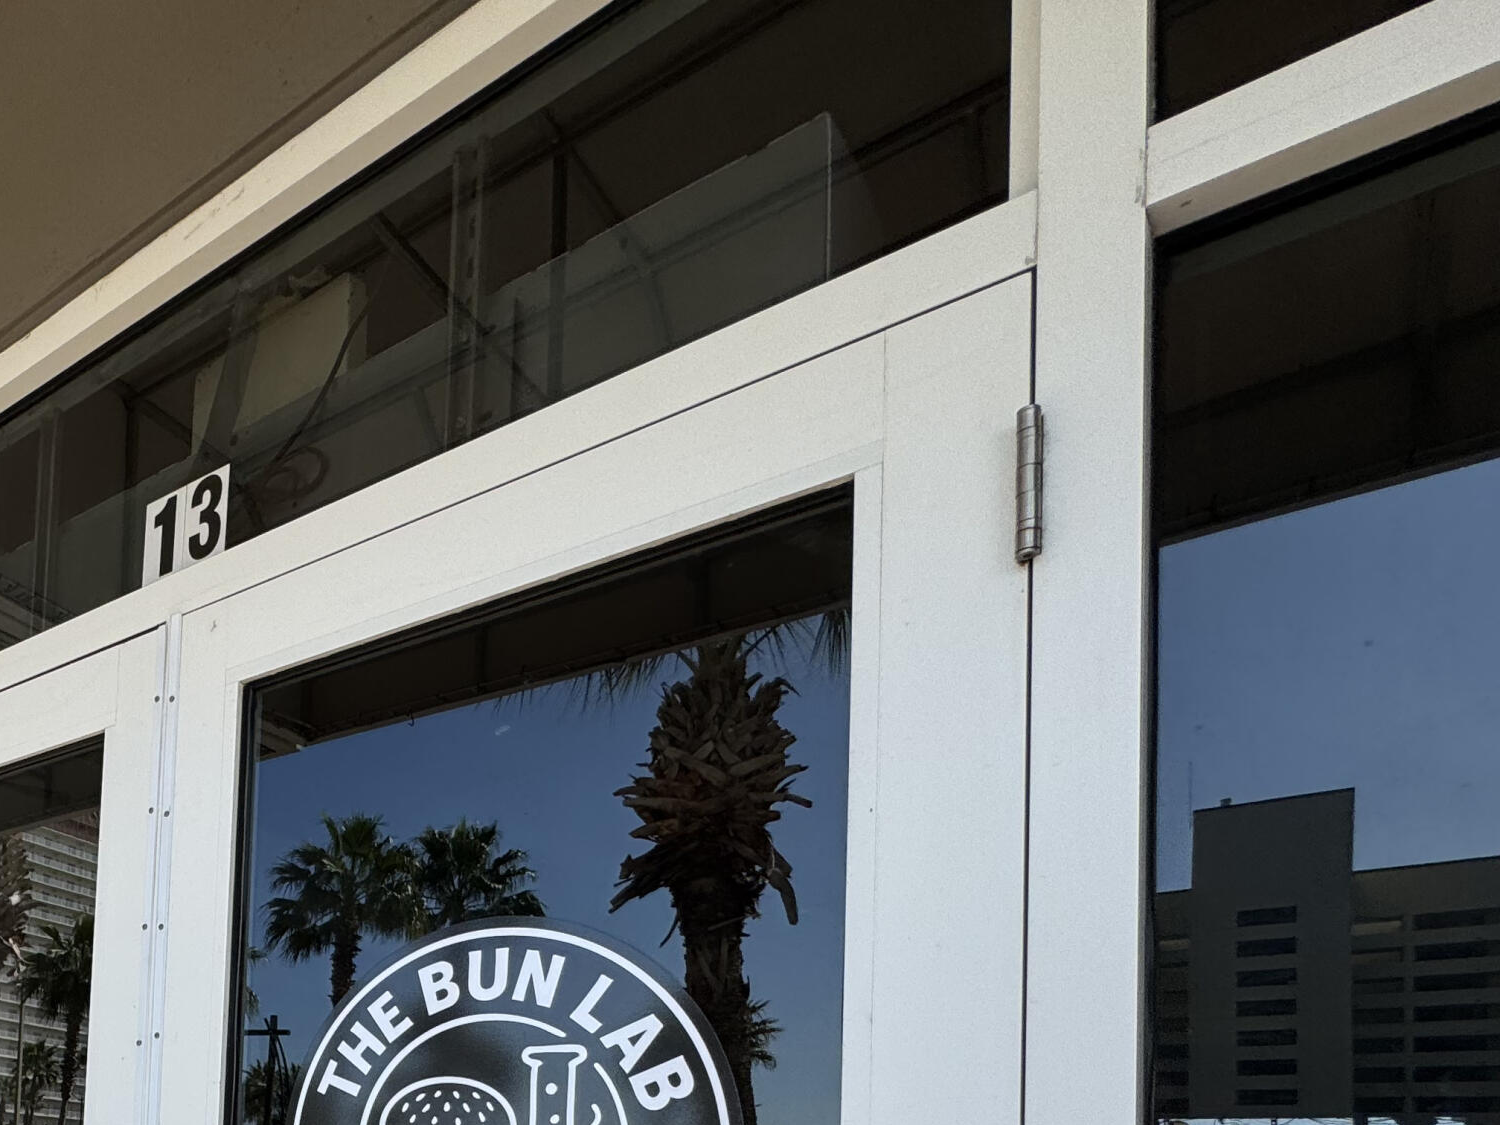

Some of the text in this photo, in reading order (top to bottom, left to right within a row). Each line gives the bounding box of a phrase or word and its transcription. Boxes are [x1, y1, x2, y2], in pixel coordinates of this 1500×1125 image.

[154, 474, 222, 577] 13
[317, 947, 695, 1111] THE BUN LAB
